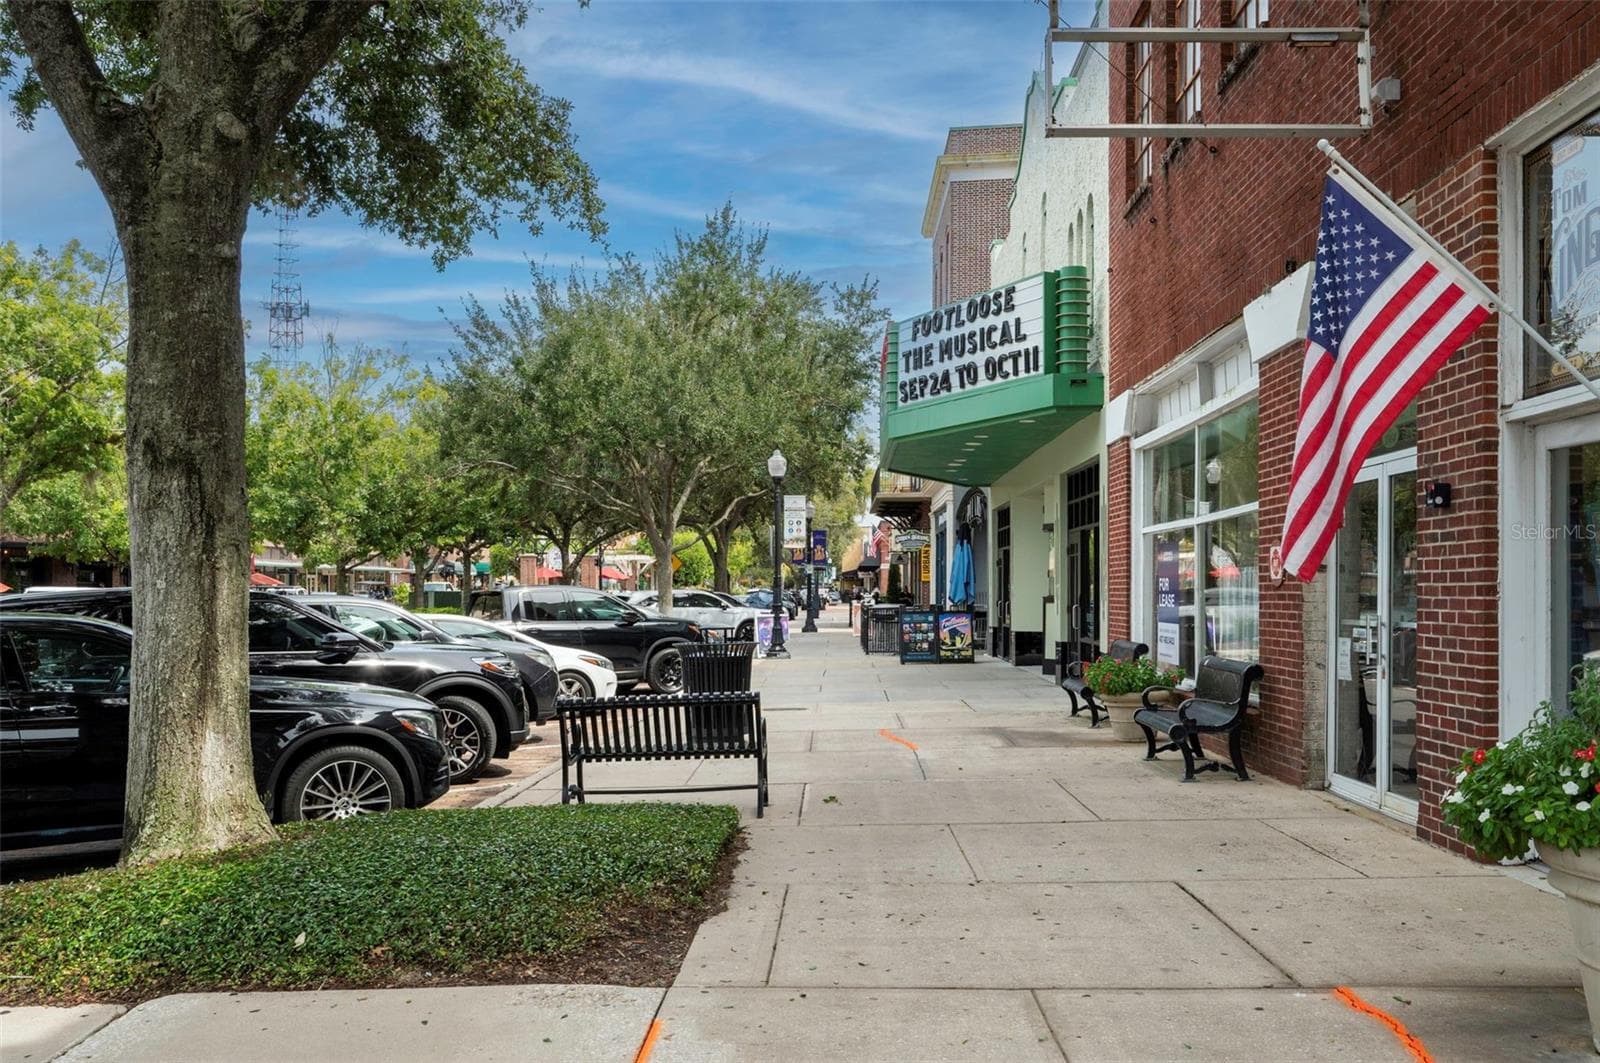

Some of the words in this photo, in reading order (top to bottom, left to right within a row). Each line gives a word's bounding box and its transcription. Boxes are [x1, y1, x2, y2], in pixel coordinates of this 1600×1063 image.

[911, 286, 1016, 342] FOOTLOOSE
[902, 342, 934, 374] THE
[938, 317, 1027, 363] MUSICAL
[899, 369, 952, 403] SEP24
[955, 361, 979, 389] TO
[922, 549, 931, 575] URBAN
[1158, 577, 1170, 592] FOR
[1158, 593, 1176, 608] LEASE
